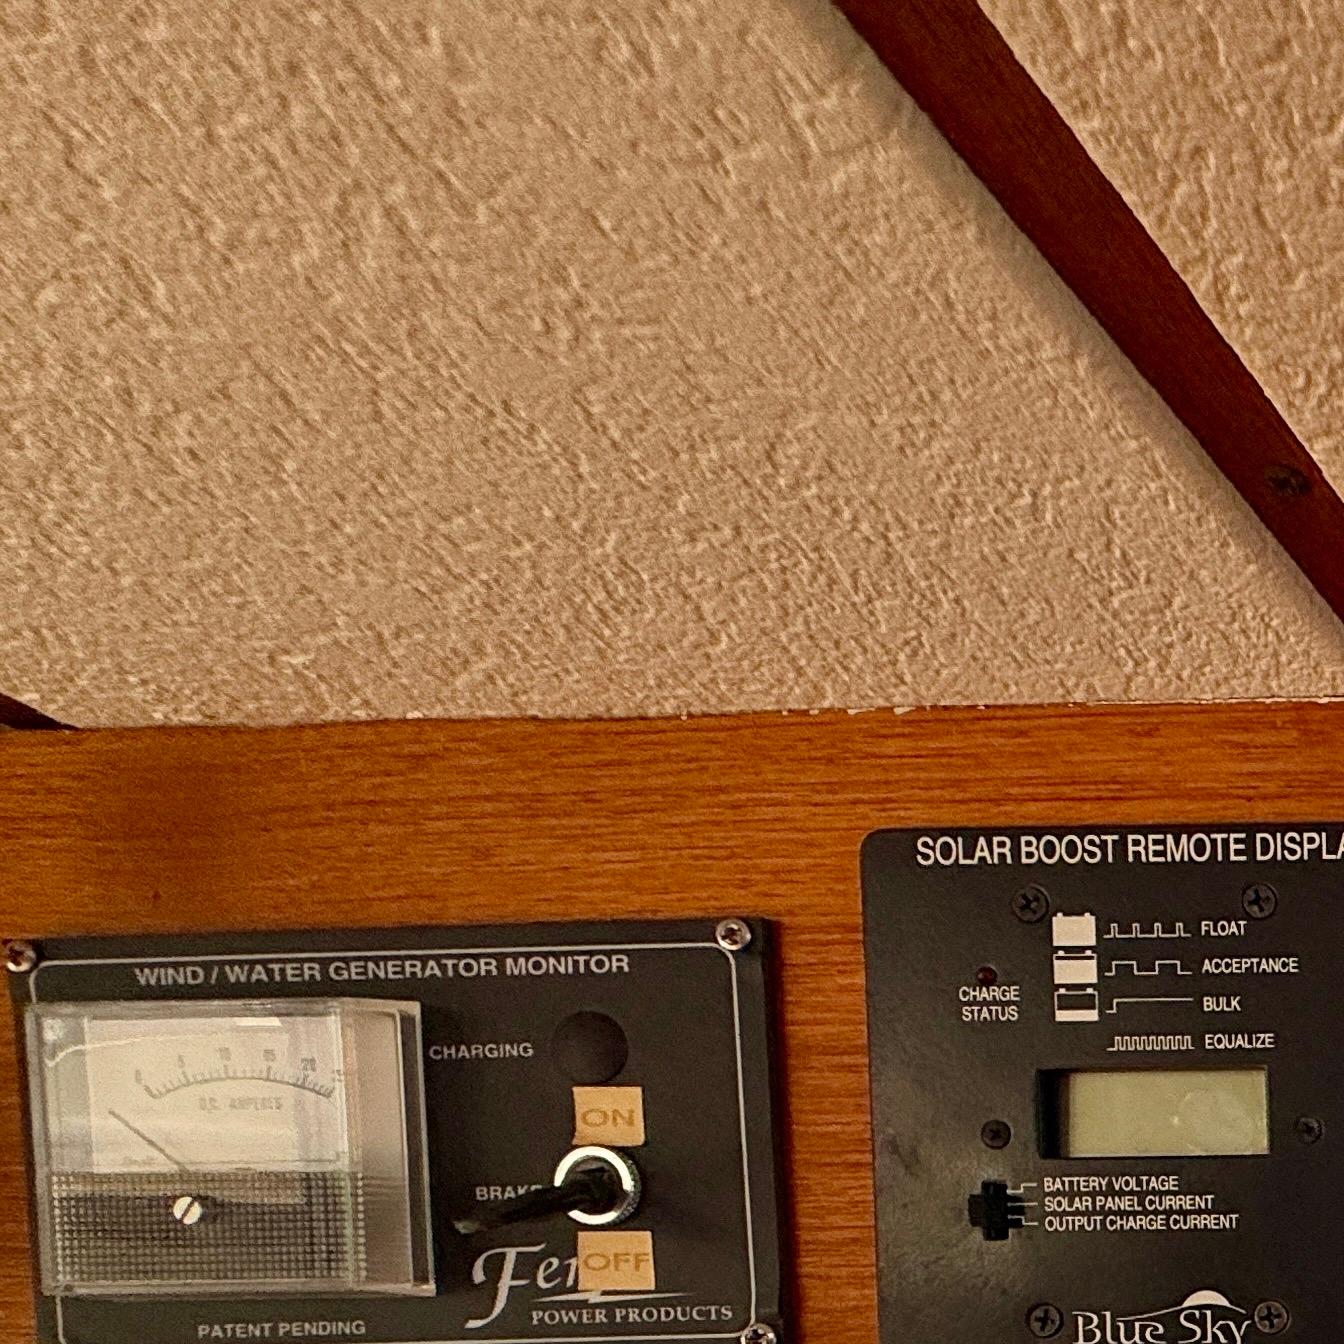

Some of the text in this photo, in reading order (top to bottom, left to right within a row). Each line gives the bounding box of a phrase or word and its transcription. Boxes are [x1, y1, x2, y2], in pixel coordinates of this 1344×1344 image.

[916, 835, 1013, 866] SOLAR
[1021, 833, 1119, 864] BOOST
[1127, 832, 1248, 862] REMOTE
[1200, 920, 1248, 937] FLOAT
[134, 954, 630, 986] WIND / WATER GENERATOR MONITOR
[1201, 957, 1299, 974] ACCEPTANCE
[959, 986, 1020, 1003] CHARGE
[1203, 996, 1241, 1013] BULK
[962, 1006, 1018, 1022] STATUS
[1204, 1033, 1275, 1050] EQUALIZE
[429, 1042, 535, 1060] CHARGING
[580, 1107, 635, 1128] ON
[475, 1184, 543, 1201] BRAK
[1043, 1176, 1179, 1192] BATTERY VOLTAGE
[1044, 1195, 1215, 1212] SOLAR PANEL CURRENT
[1044, 1214, 1239, 1231] OUTPUT CHARGE CURRENT
[582, 1252, 650, 1272] OFF
[531, 1305, 732, 1325] POWER PRODUCTS
[198, 1320, 366, 1339] PATENT PENDING
